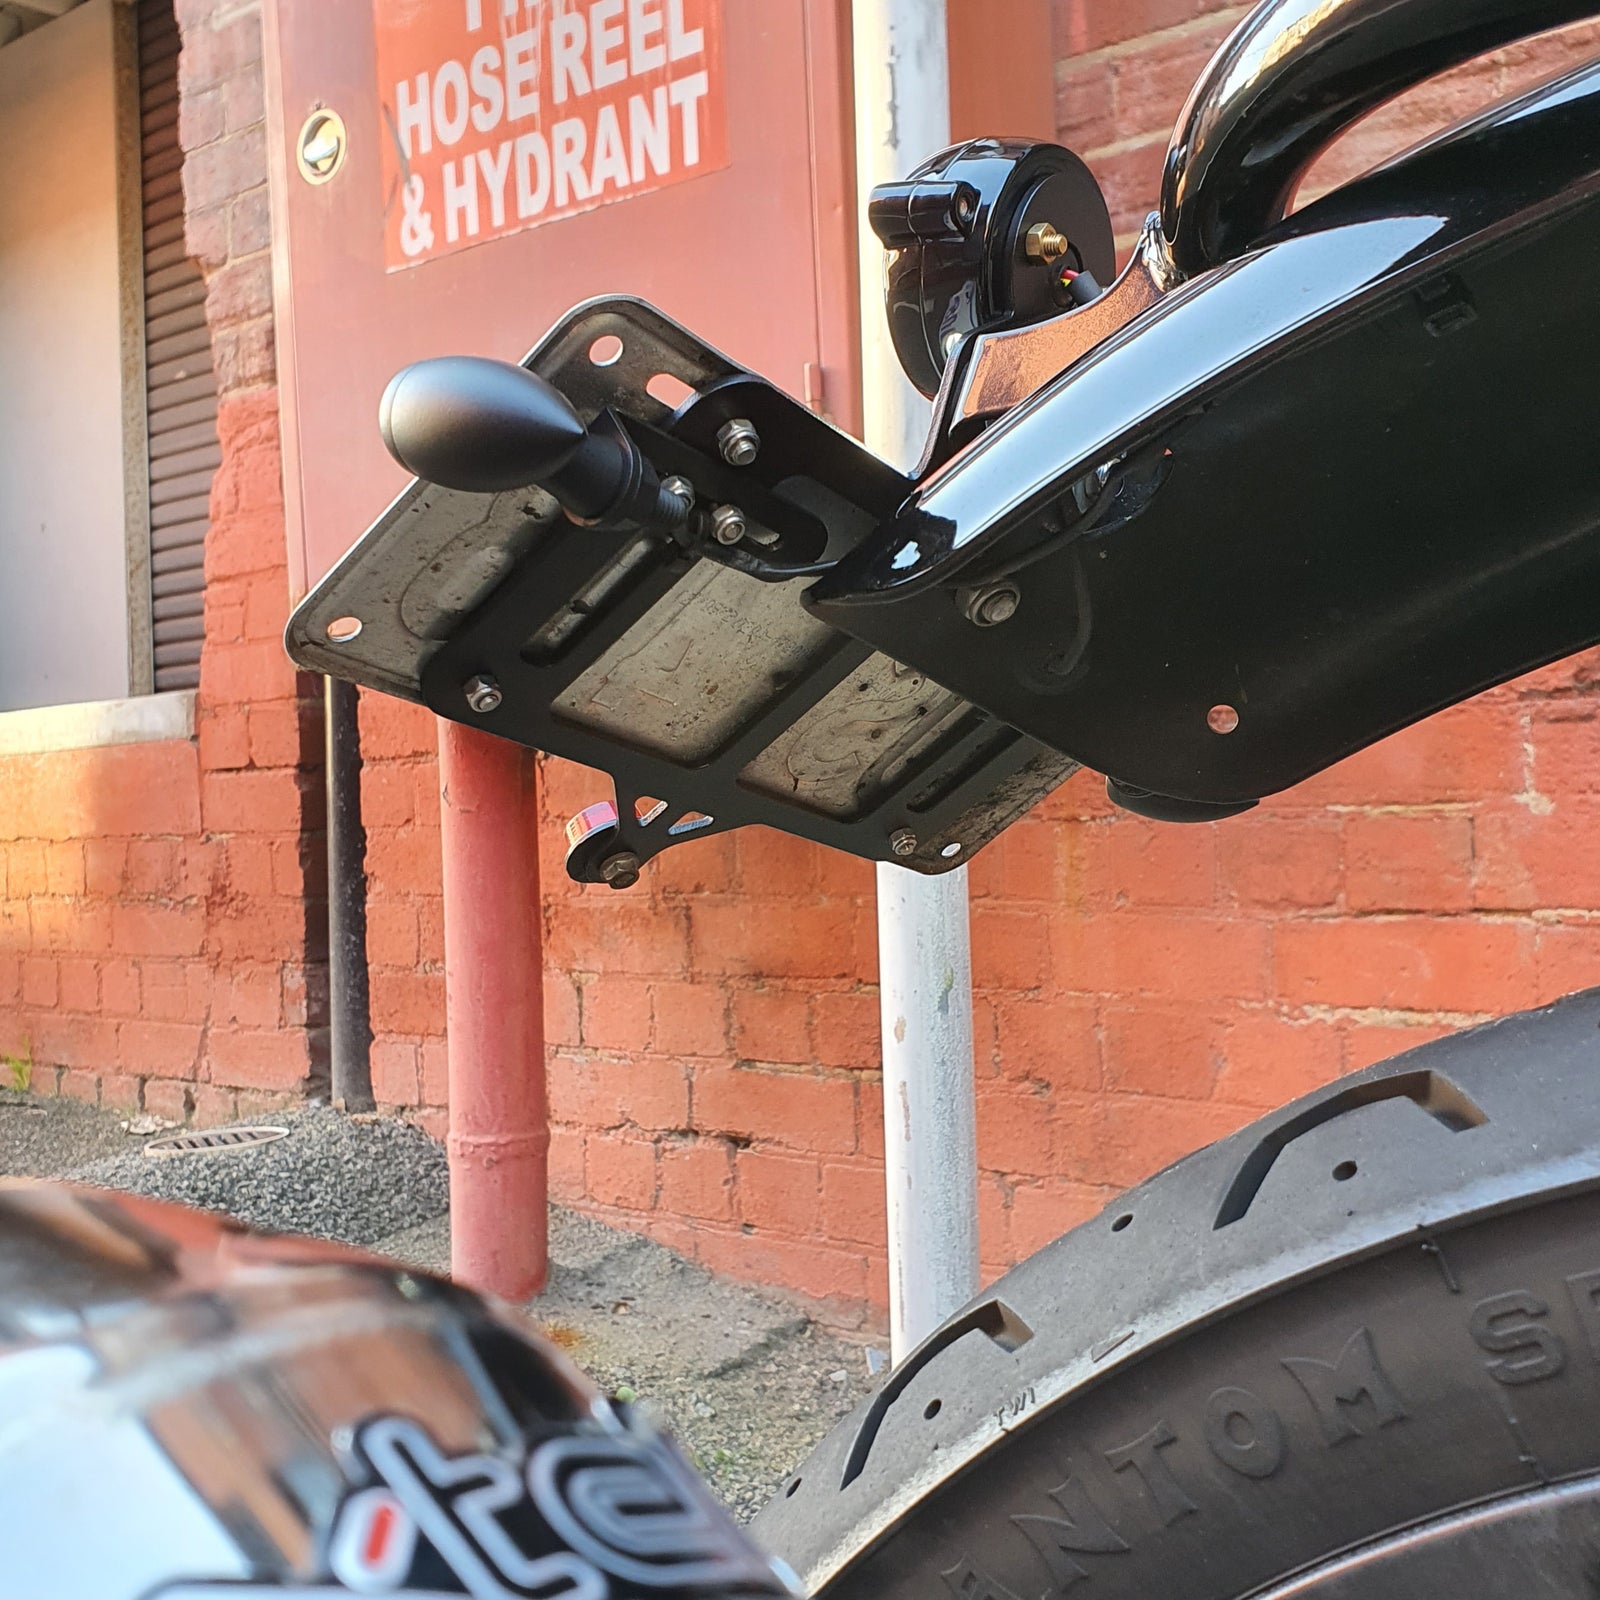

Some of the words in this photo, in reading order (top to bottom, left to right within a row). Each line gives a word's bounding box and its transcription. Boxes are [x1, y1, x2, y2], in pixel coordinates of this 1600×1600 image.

[396, 28, 540, 160] HOSE
[550, 0, 704, 105] REEL
[400, 173, 434, 257] &
[443, 70, 708, 243] HYDRANT
